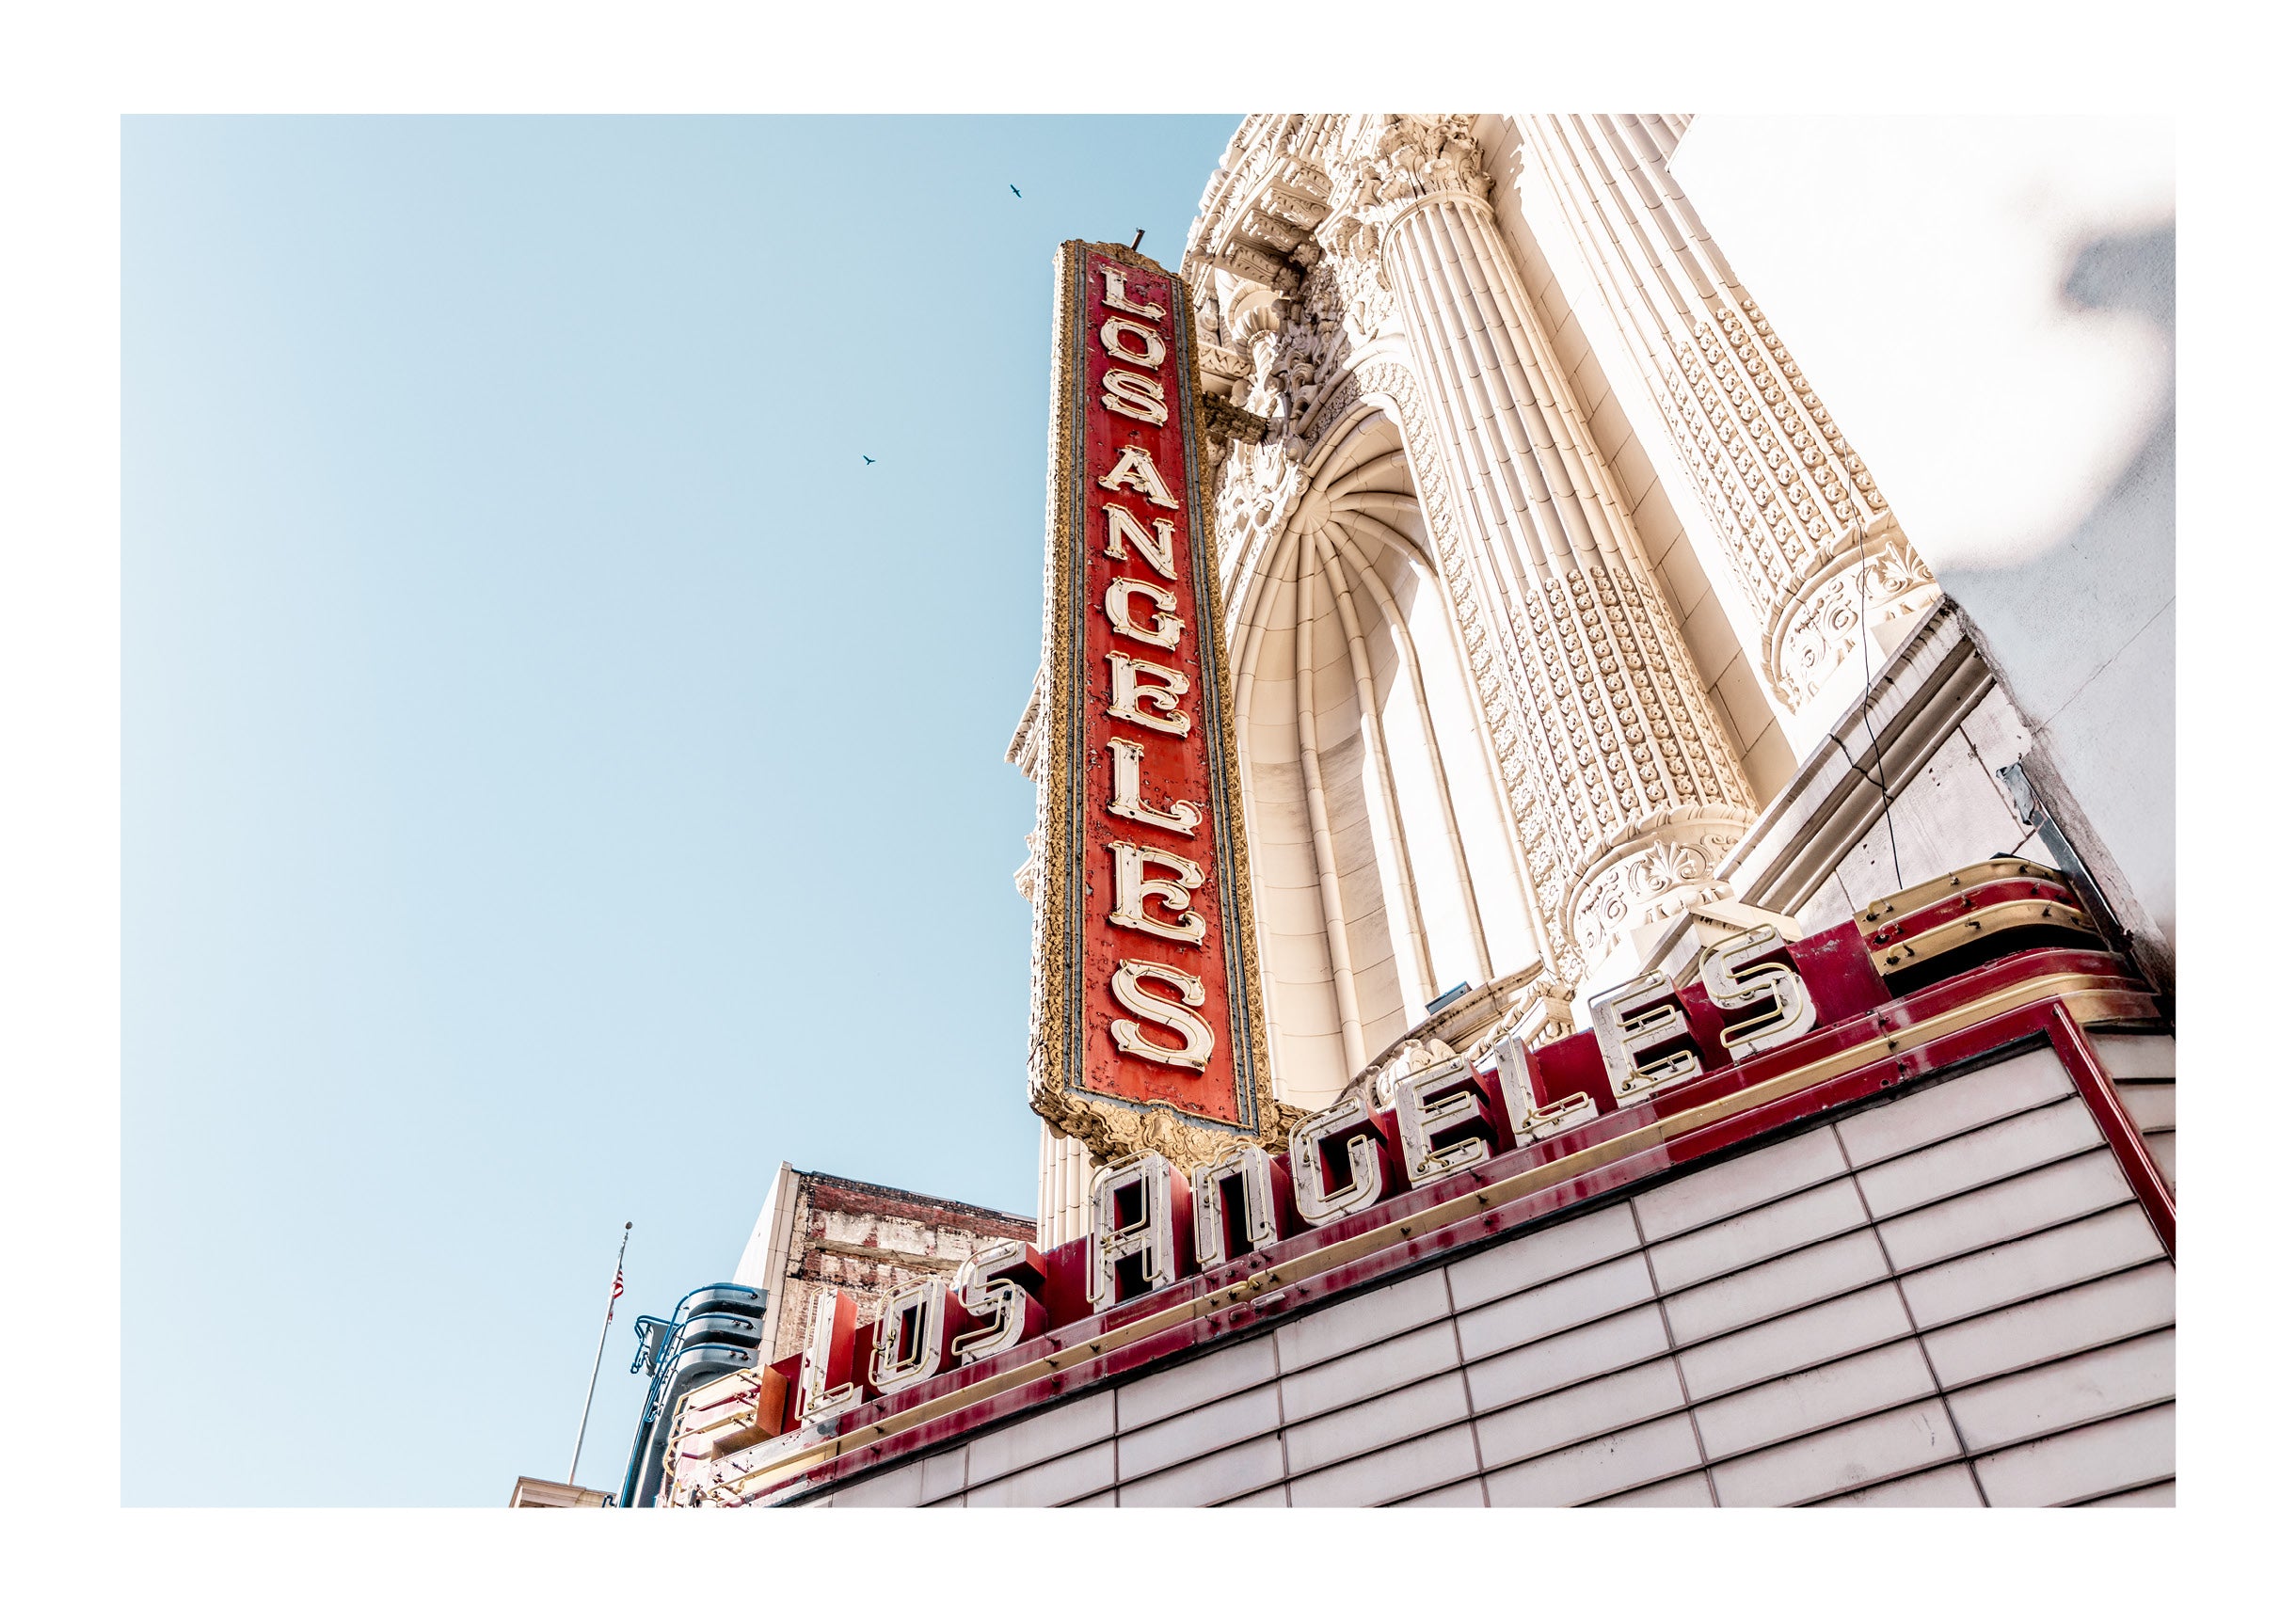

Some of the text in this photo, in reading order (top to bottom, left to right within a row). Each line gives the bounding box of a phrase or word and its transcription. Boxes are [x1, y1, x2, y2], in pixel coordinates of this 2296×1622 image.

[1097, 266, 1215, 1074] LOS ANGELES
[794, 923, 1817, 1426] LOS ANGELES
